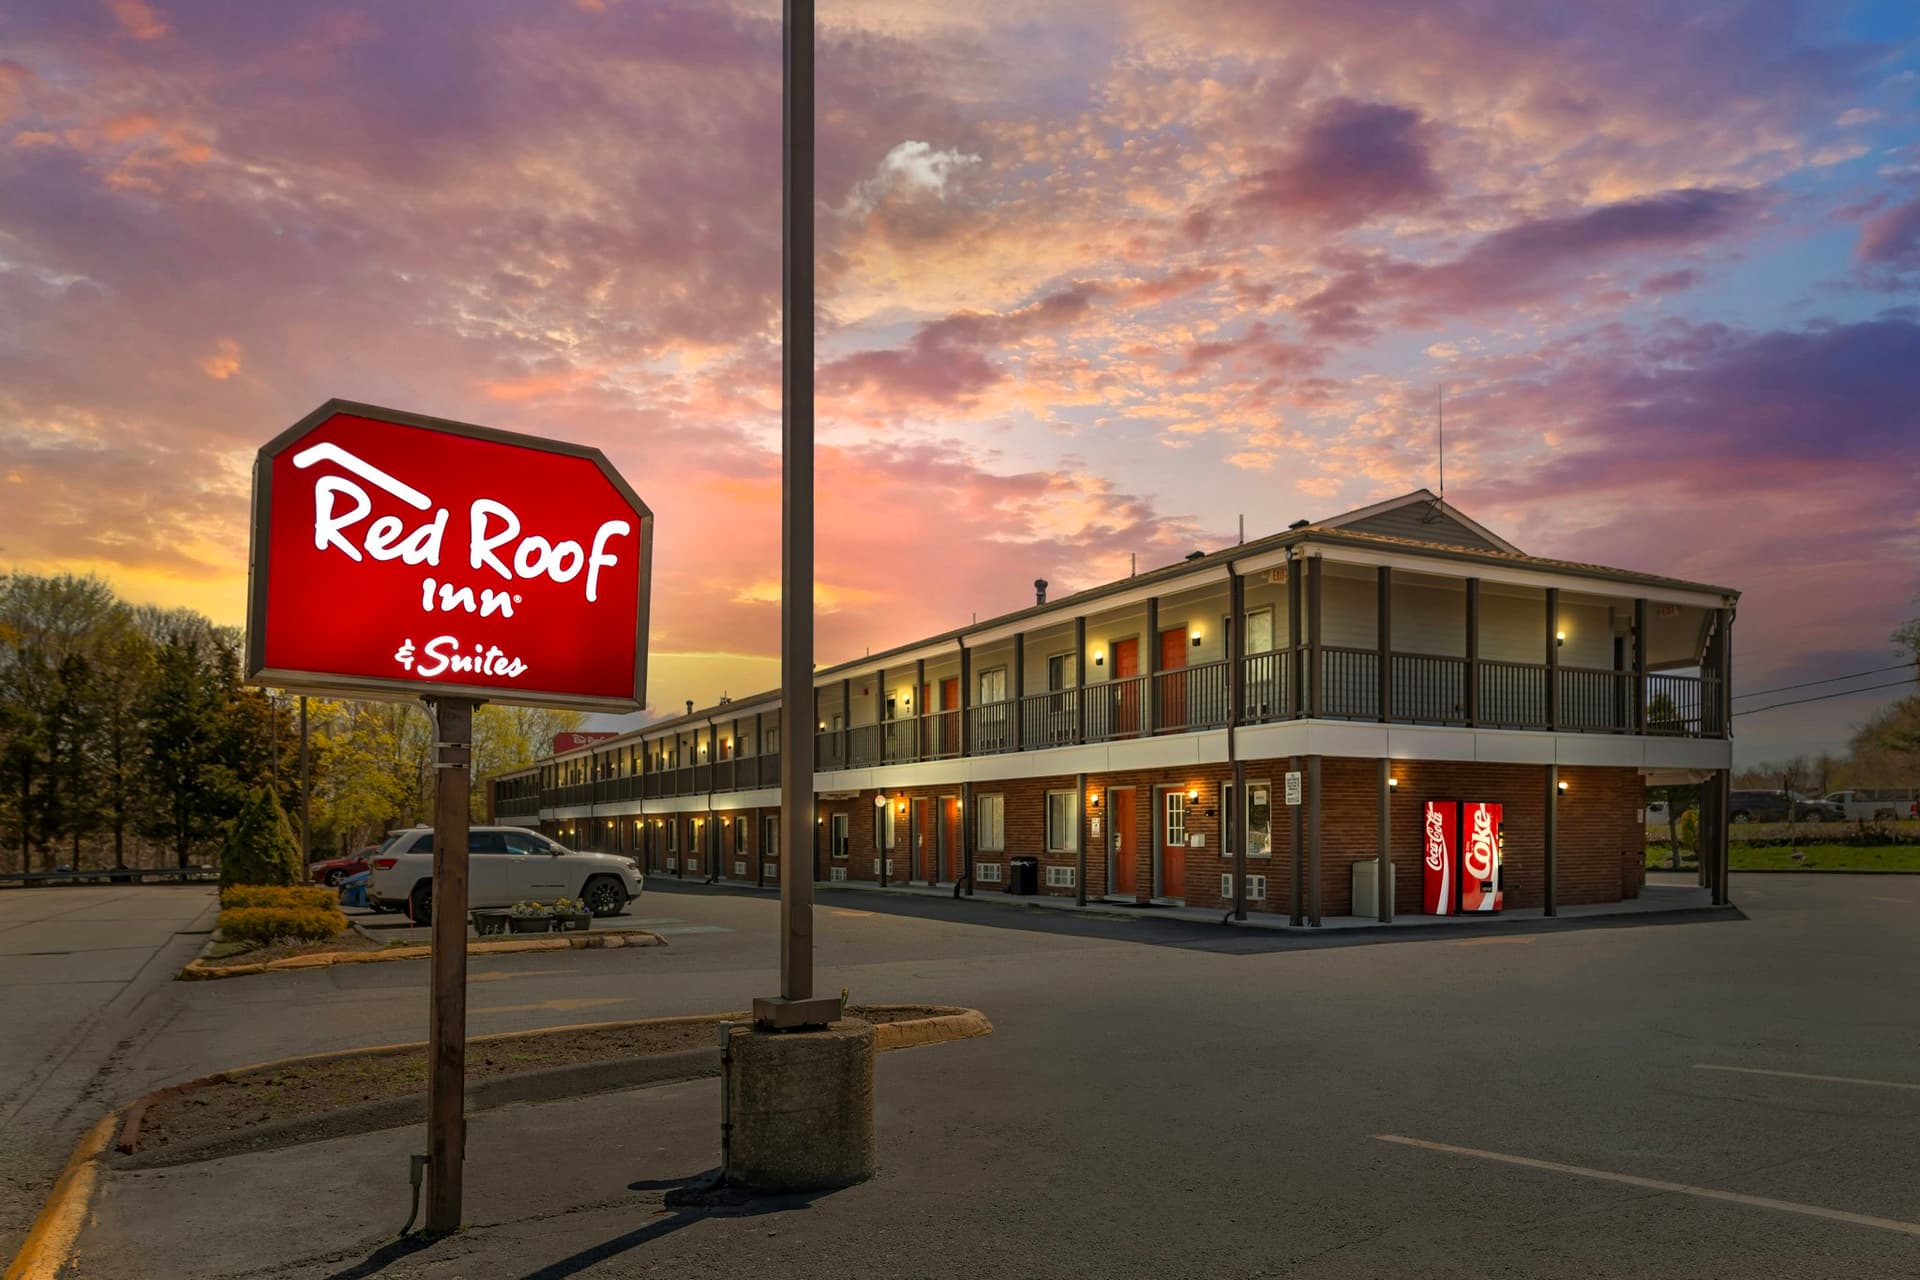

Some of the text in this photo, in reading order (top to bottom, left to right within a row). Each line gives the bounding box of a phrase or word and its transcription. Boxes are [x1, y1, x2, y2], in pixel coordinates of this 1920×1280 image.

[314, 475, 631, 603] Red Roof
[394, 635, 529, 678] & Suites
[1465, 808, 1491, 880] Coke
